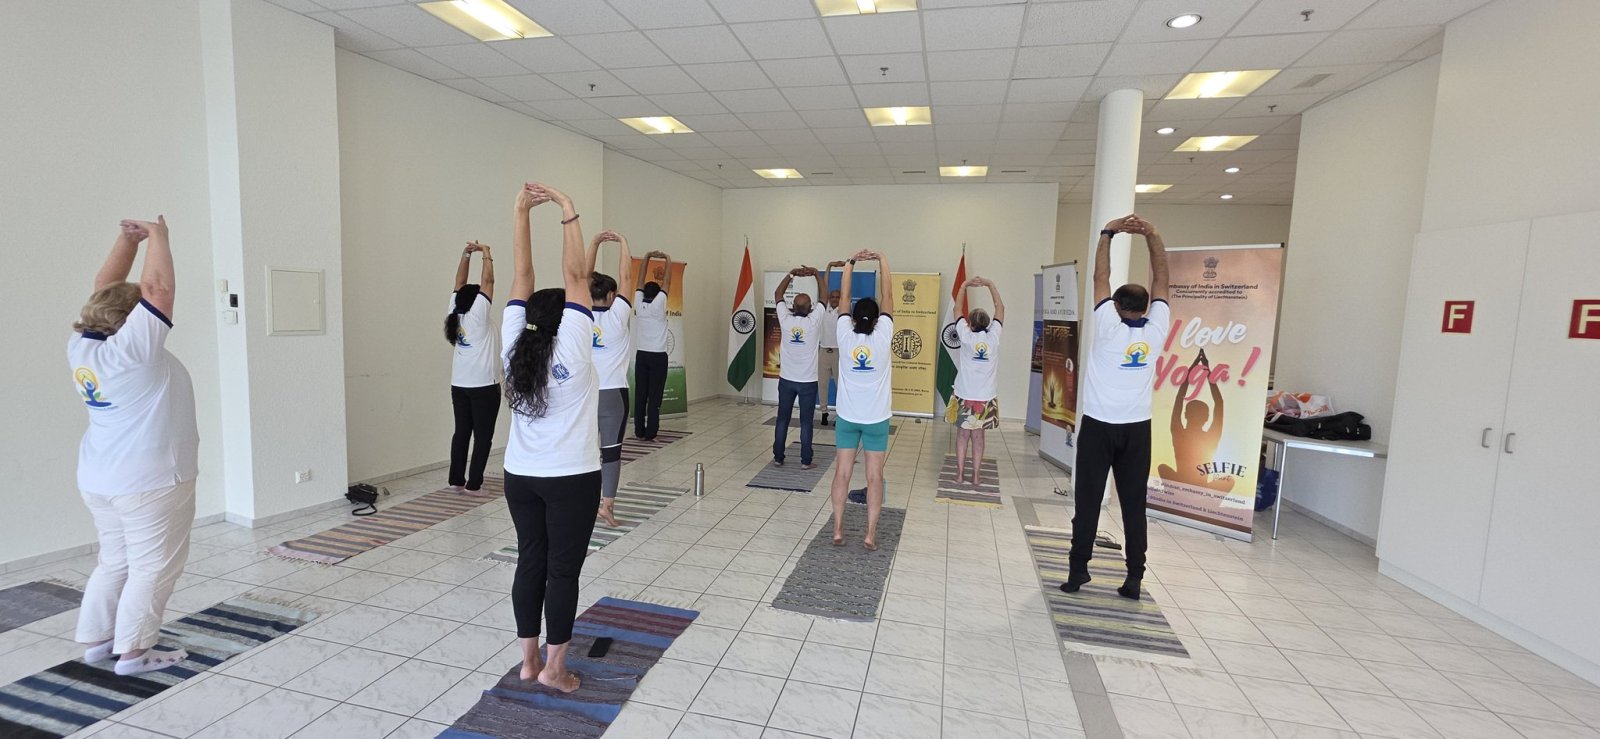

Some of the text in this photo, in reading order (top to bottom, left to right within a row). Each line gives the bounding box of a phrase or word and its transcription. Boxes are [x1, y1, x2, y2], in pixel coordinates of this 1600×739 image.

[1448, 304, 1468, 329] F
[1578, 304, 1600, 334] F
[1164, 316, 1248, 352] I love
[1154, 354, 1230, 401] Yoga
[1196, 462, 1247, 478] SELFIE
